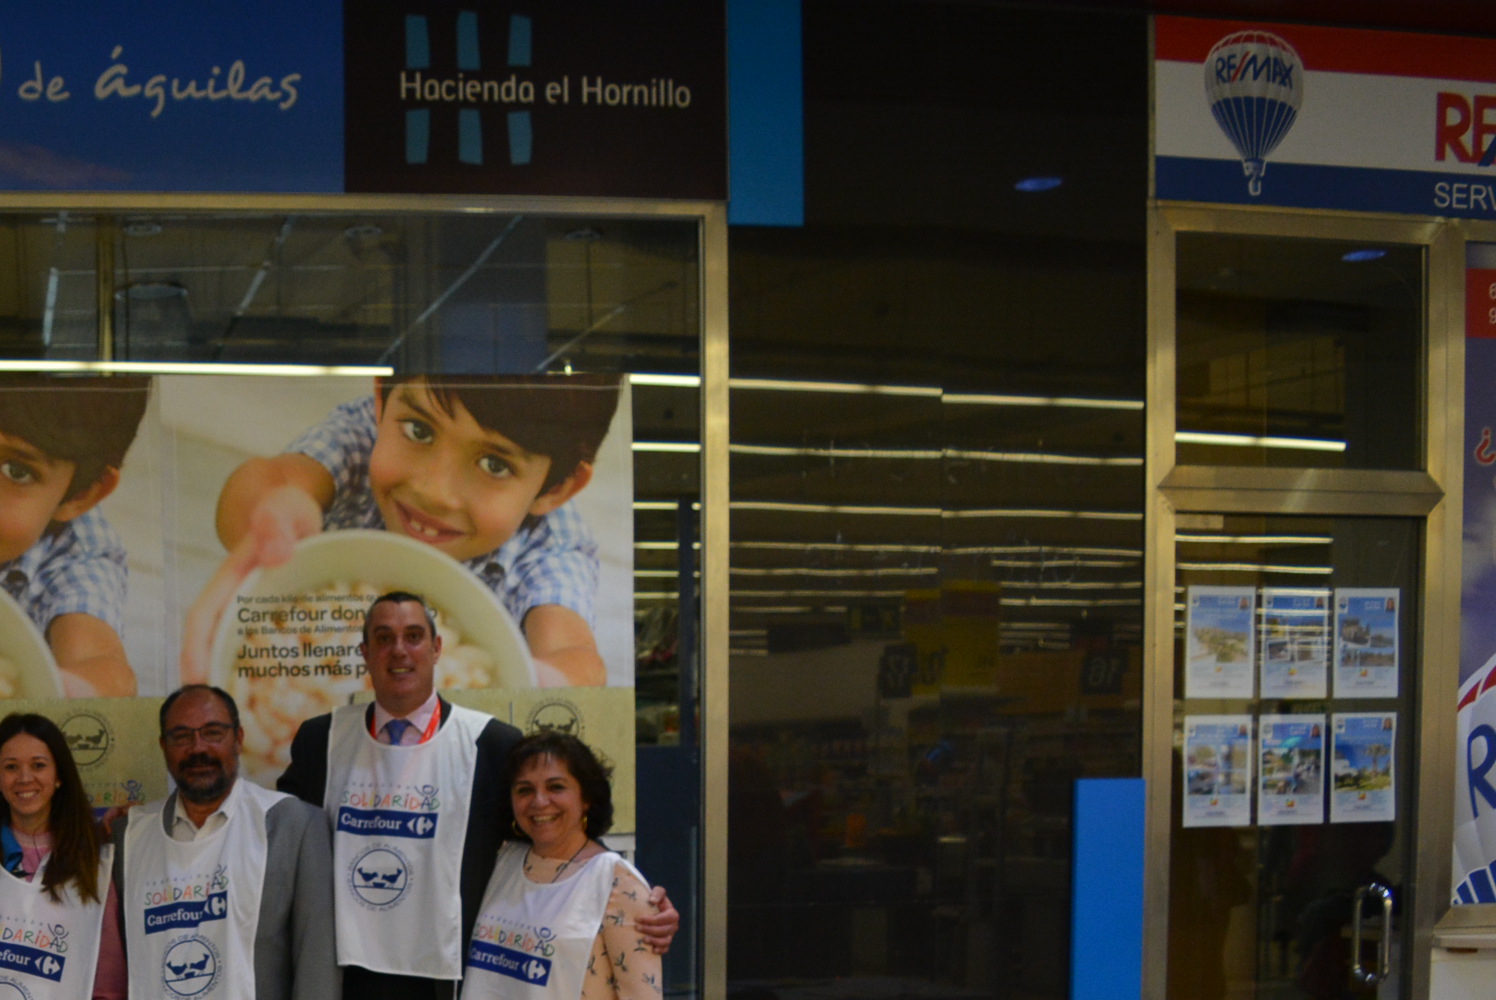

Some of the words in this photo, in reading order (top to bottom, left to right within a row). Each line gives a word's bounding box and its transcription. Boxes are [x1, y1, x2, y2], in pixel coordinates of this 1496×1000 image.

[17, 59, 70, 102] de
[398, 69, 534, 104] Hacienda
[544, 73, 570, 103] el
[579, 74, 692, 109] Hornillo
[237, 606, 328, 623] Carrefour
[237, 643, 299, 659] Juntos
[238, 662, 311, 678] muchos
[314, 660, 352, 677] más
[340, 812, 403, 830] Carrefour
